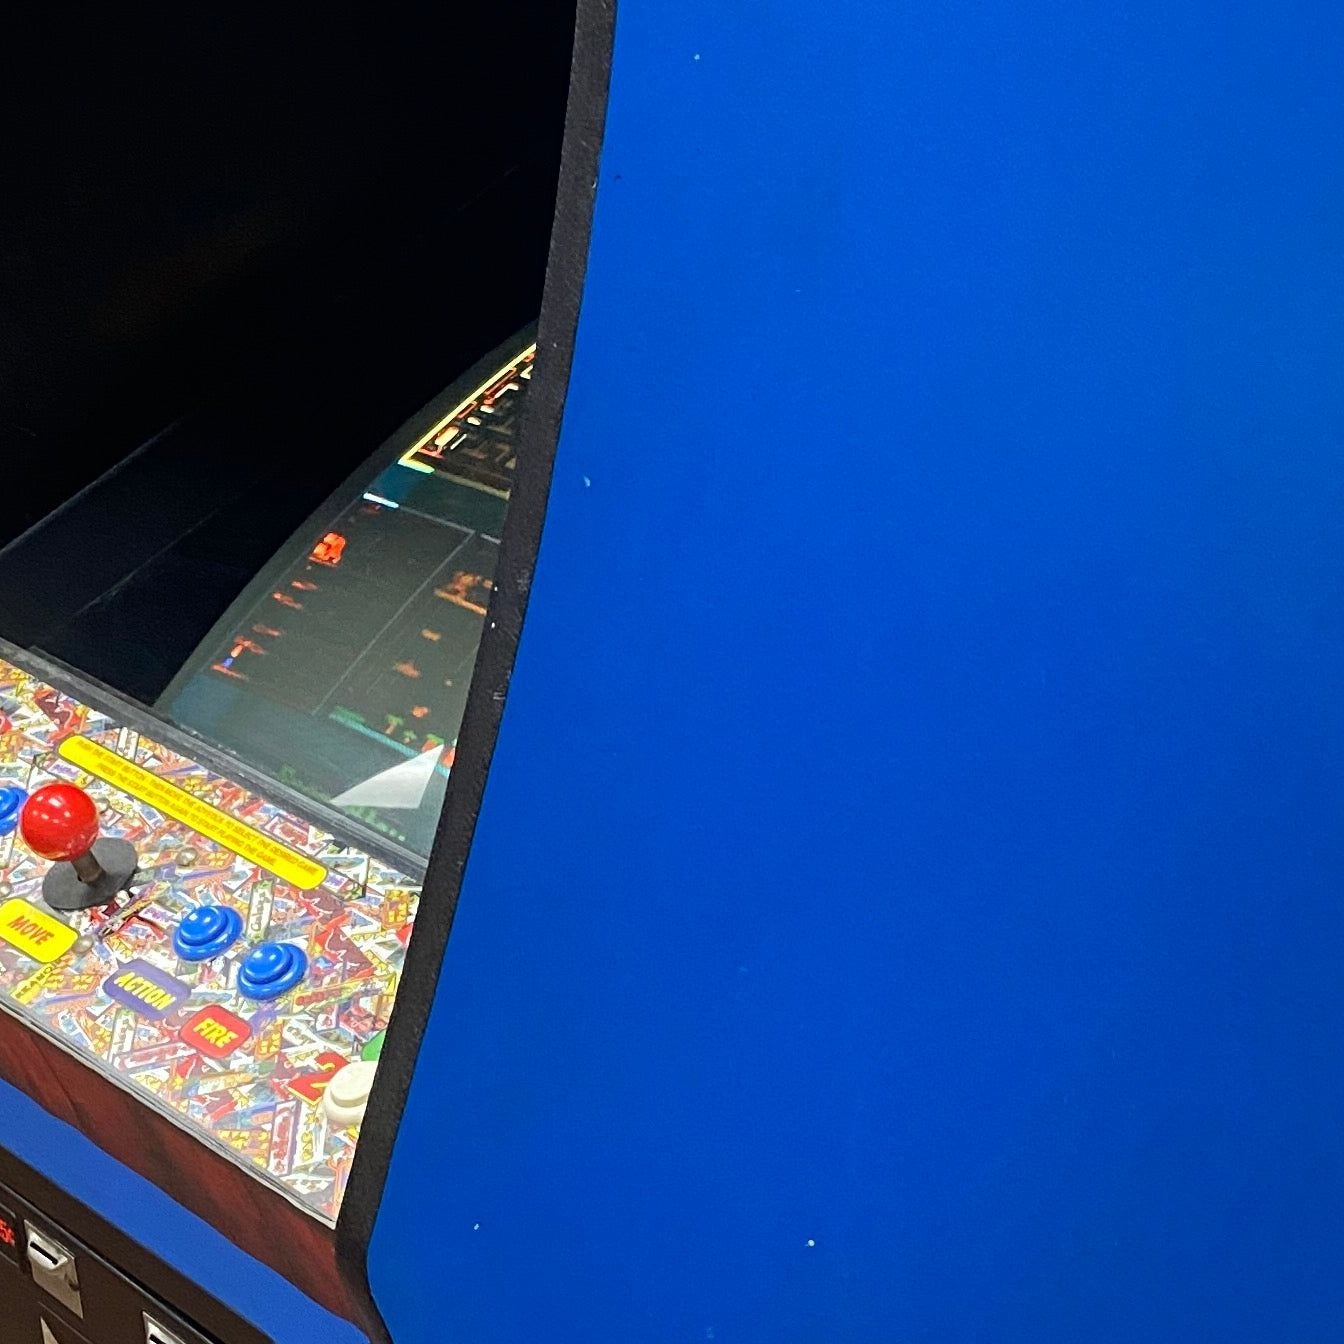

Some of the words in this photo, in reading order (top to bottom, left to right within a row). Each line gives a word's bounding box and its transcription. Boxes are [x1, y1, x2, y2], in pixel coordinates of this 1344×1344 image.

[8, 915, 55, 946] MOVE
[113, 971, 176, 1011] ACTION
[193, 1017, 239, 1048] FIRE
